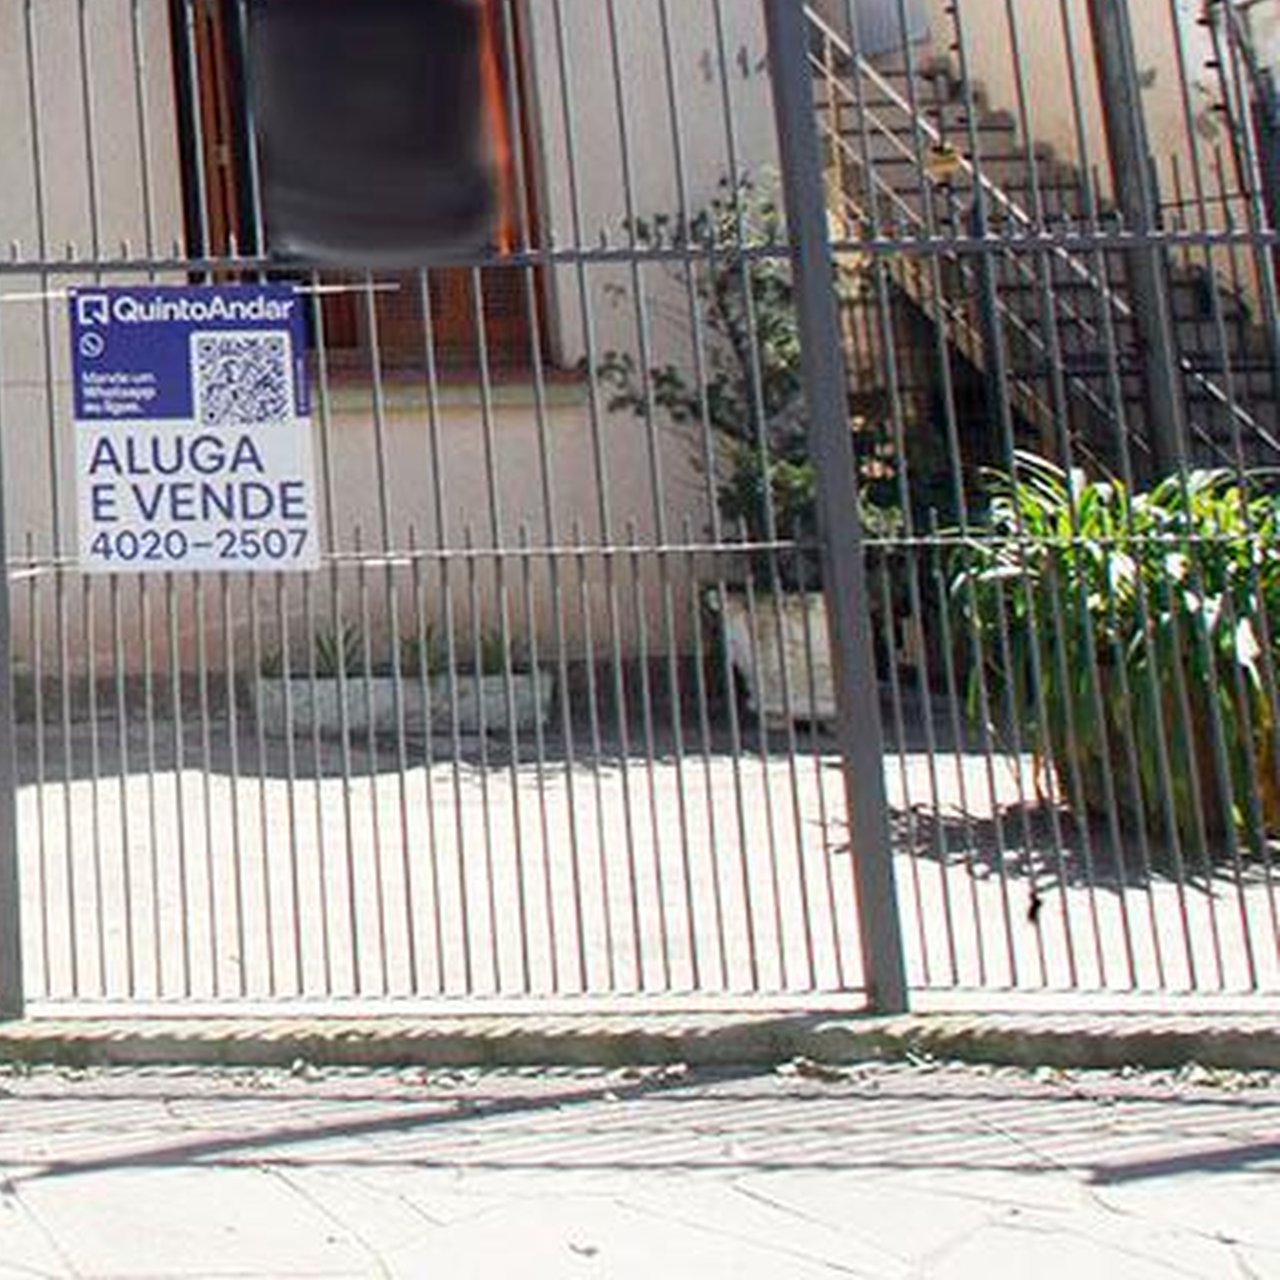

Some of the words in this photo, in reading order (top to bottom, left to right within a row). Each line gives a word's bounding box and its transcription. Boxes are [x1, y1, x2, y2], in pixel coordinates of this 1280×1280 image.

[113, 294, 295, 322] QuintoAndar
[89, 434, 266, 475] ALUGA
[93, 484, 120, 521] E
[131, 481, 308, 522] VENDE
[91, 528, 309, 561] 4020-2507
